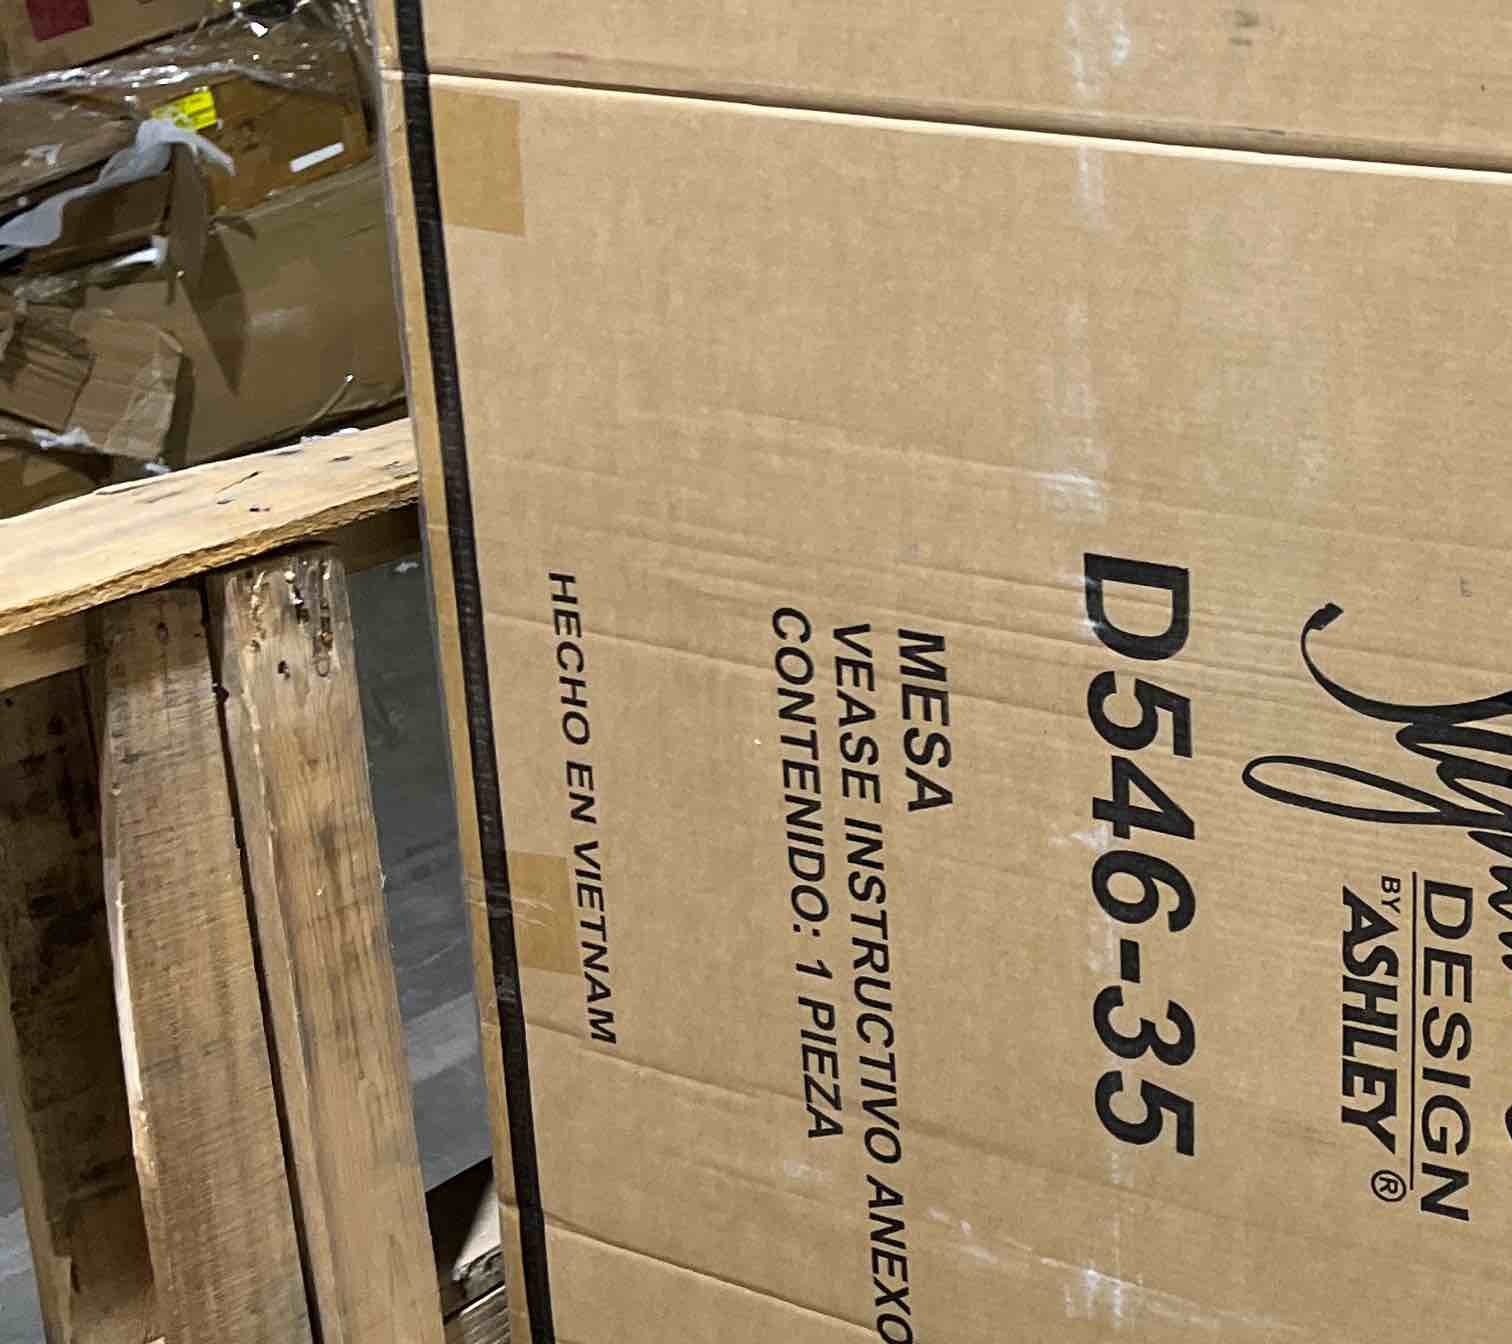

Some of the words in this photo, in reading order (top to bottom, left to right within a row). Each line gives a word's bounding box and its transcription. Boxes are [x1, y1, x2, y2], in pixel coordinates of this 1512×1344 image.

[549, 573, 589, 744] HECHO
[834, 624, 880, 803] VEASE
[898, 629, 952, 811] MESA
[567, 761, 596, 824] EN
[773, 608, 828, 937] CONTENIDO:
[1084, 553, 1195, 1156] D546-35
[574, 841, 616, 1044] VIETNAM
[796, 960, 832, 979] 1
[1382, 876, 1400, 912] BY
[798, 996, 843, 1138] PIEZA
[845, 818, 901, 1163] INSTRUCTIVO
[1421, 880, 1472, 1221] DESIGN
